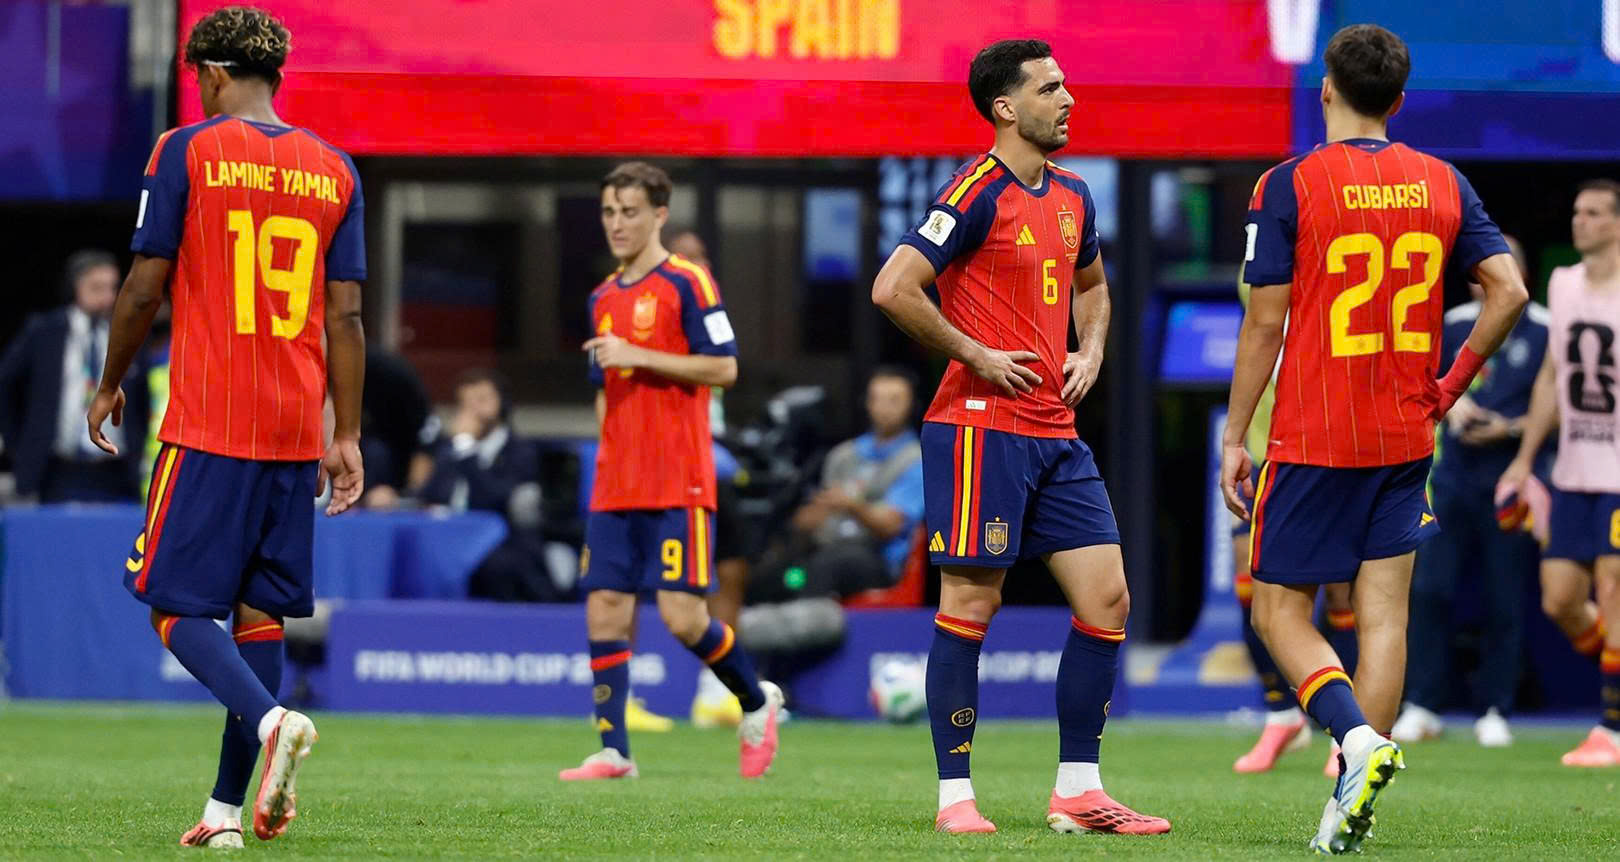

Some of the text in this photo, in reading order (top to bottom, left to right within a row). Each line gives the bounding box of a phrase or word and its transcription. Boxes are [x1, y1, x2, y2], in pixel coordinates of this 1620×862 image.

[713, 0, 901, 59] SPAIN
[204, 160, 341, 204] LAMINE YAMAL
[228, 209, 319, 341] 19
[1043, 258, 1059, 305] 6
[1326, 231, 1444, 358] 22
[661, 538, 683, 581] 9
[355, 651, 413, 683] FIFA
[416, 651, 513, 683] WORLD
[514, 651, 569, 684] CUP
